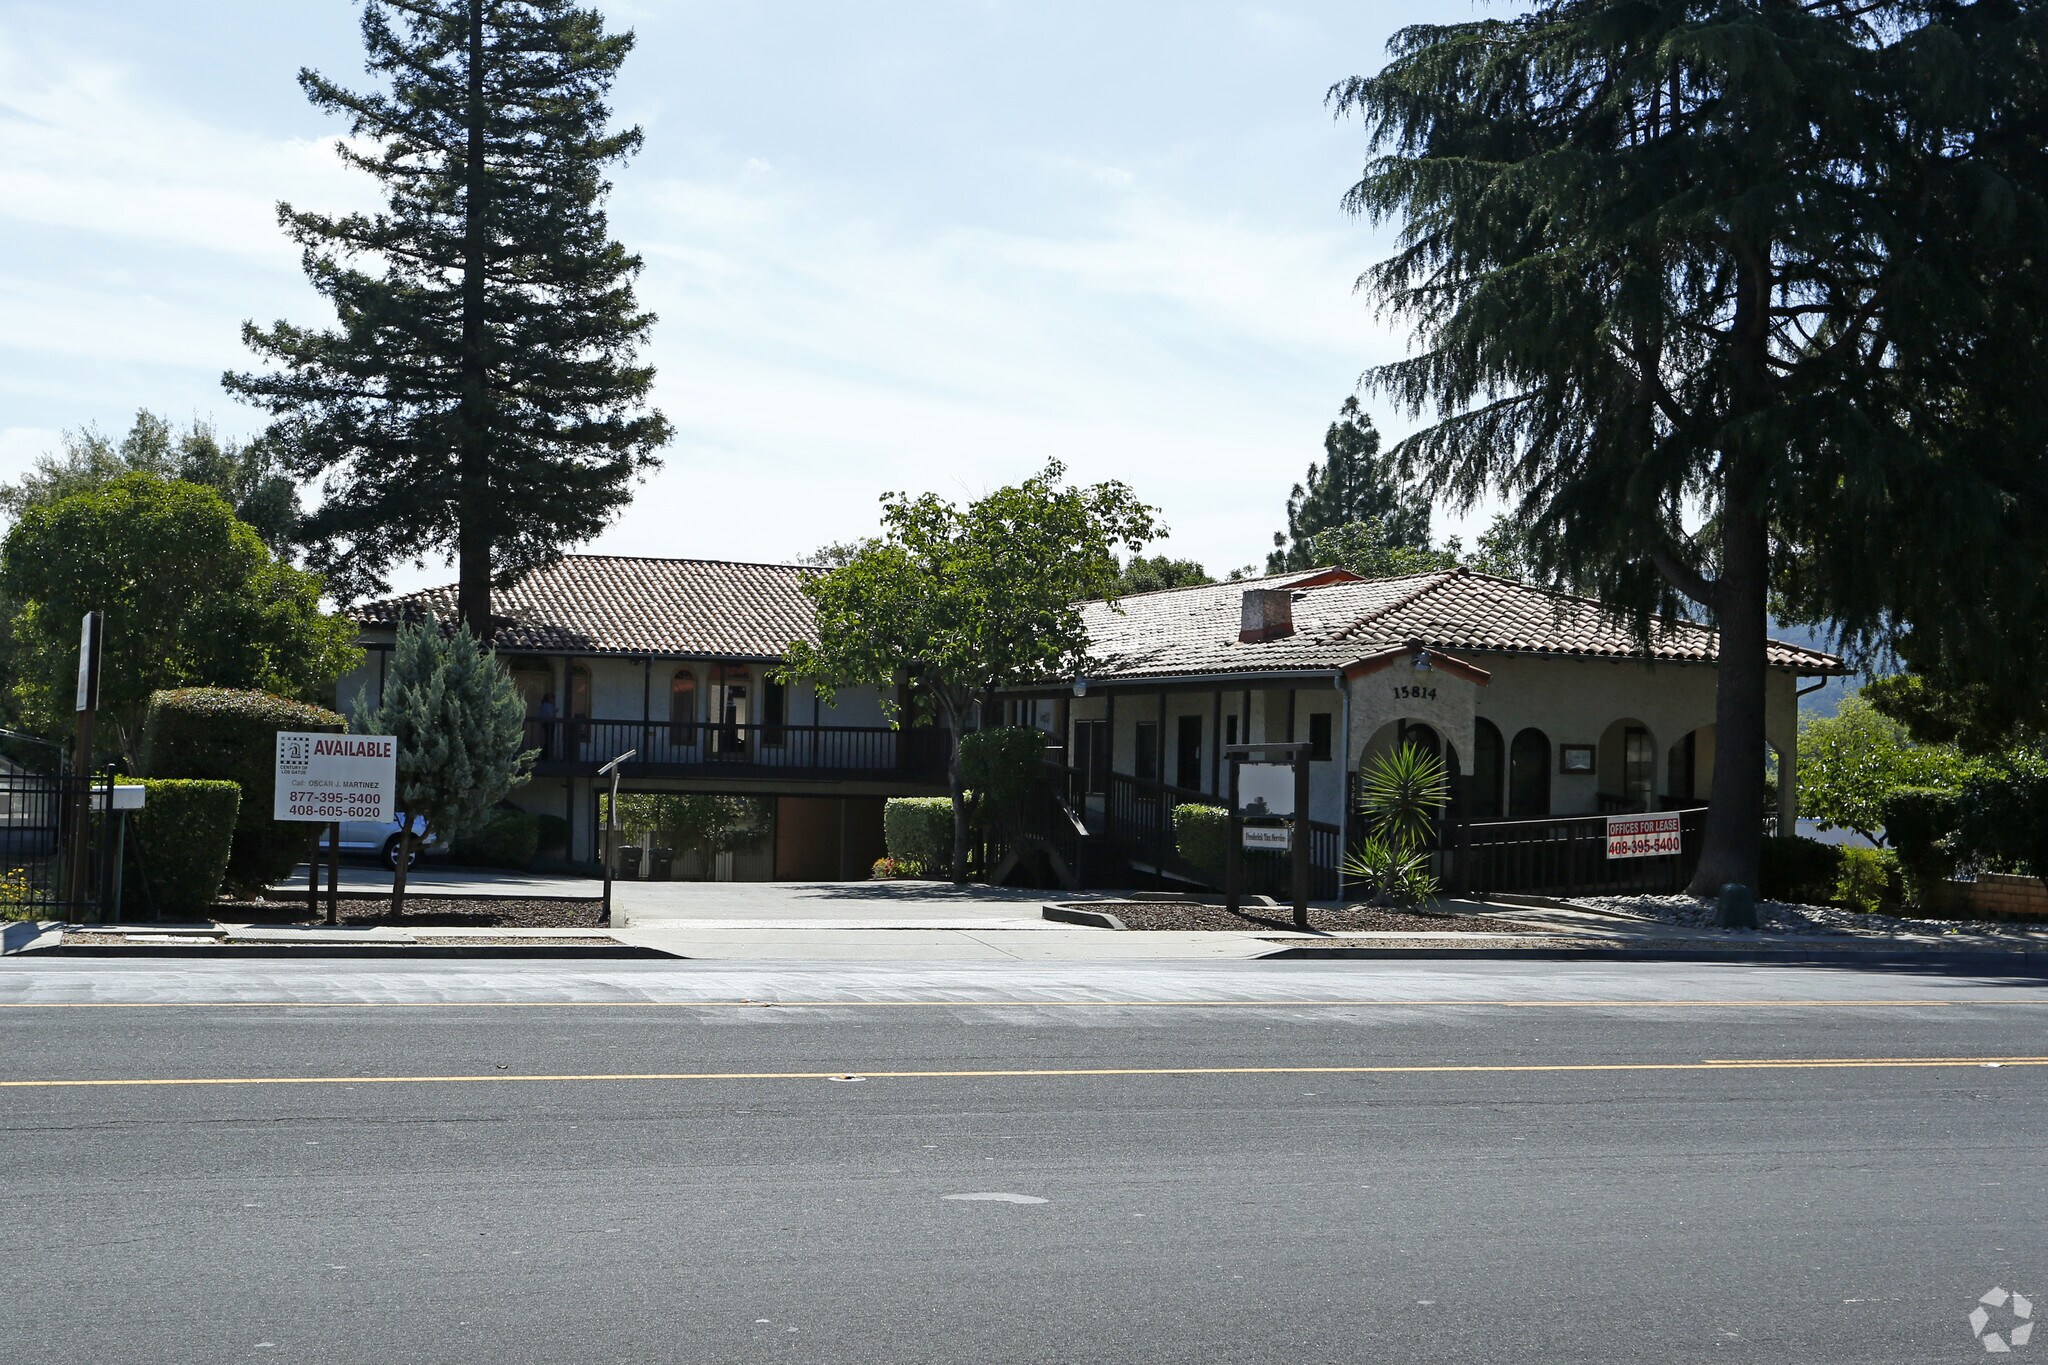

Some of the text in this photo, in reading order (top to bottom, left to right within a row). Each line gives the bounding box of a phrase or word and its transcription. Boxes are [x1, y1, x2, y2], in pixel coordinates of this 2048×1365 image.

[1393, 685, 1437, 700] 15814
[314, 739, 391, 758] AVAILABLE
[308, 779, 334, 787] OSCAR
[335, 780, 341, 788] J.
[343, 781, 379, 789] MARTINEZ
[289, 791, 381, 804] 877-395-5400
[289, 804, 380, 818] 408-605-6020
[1610, 820, 1677, 834] OFFICES FOR LEASE
[1609, 837, 1679, 854] 408-395-5400
